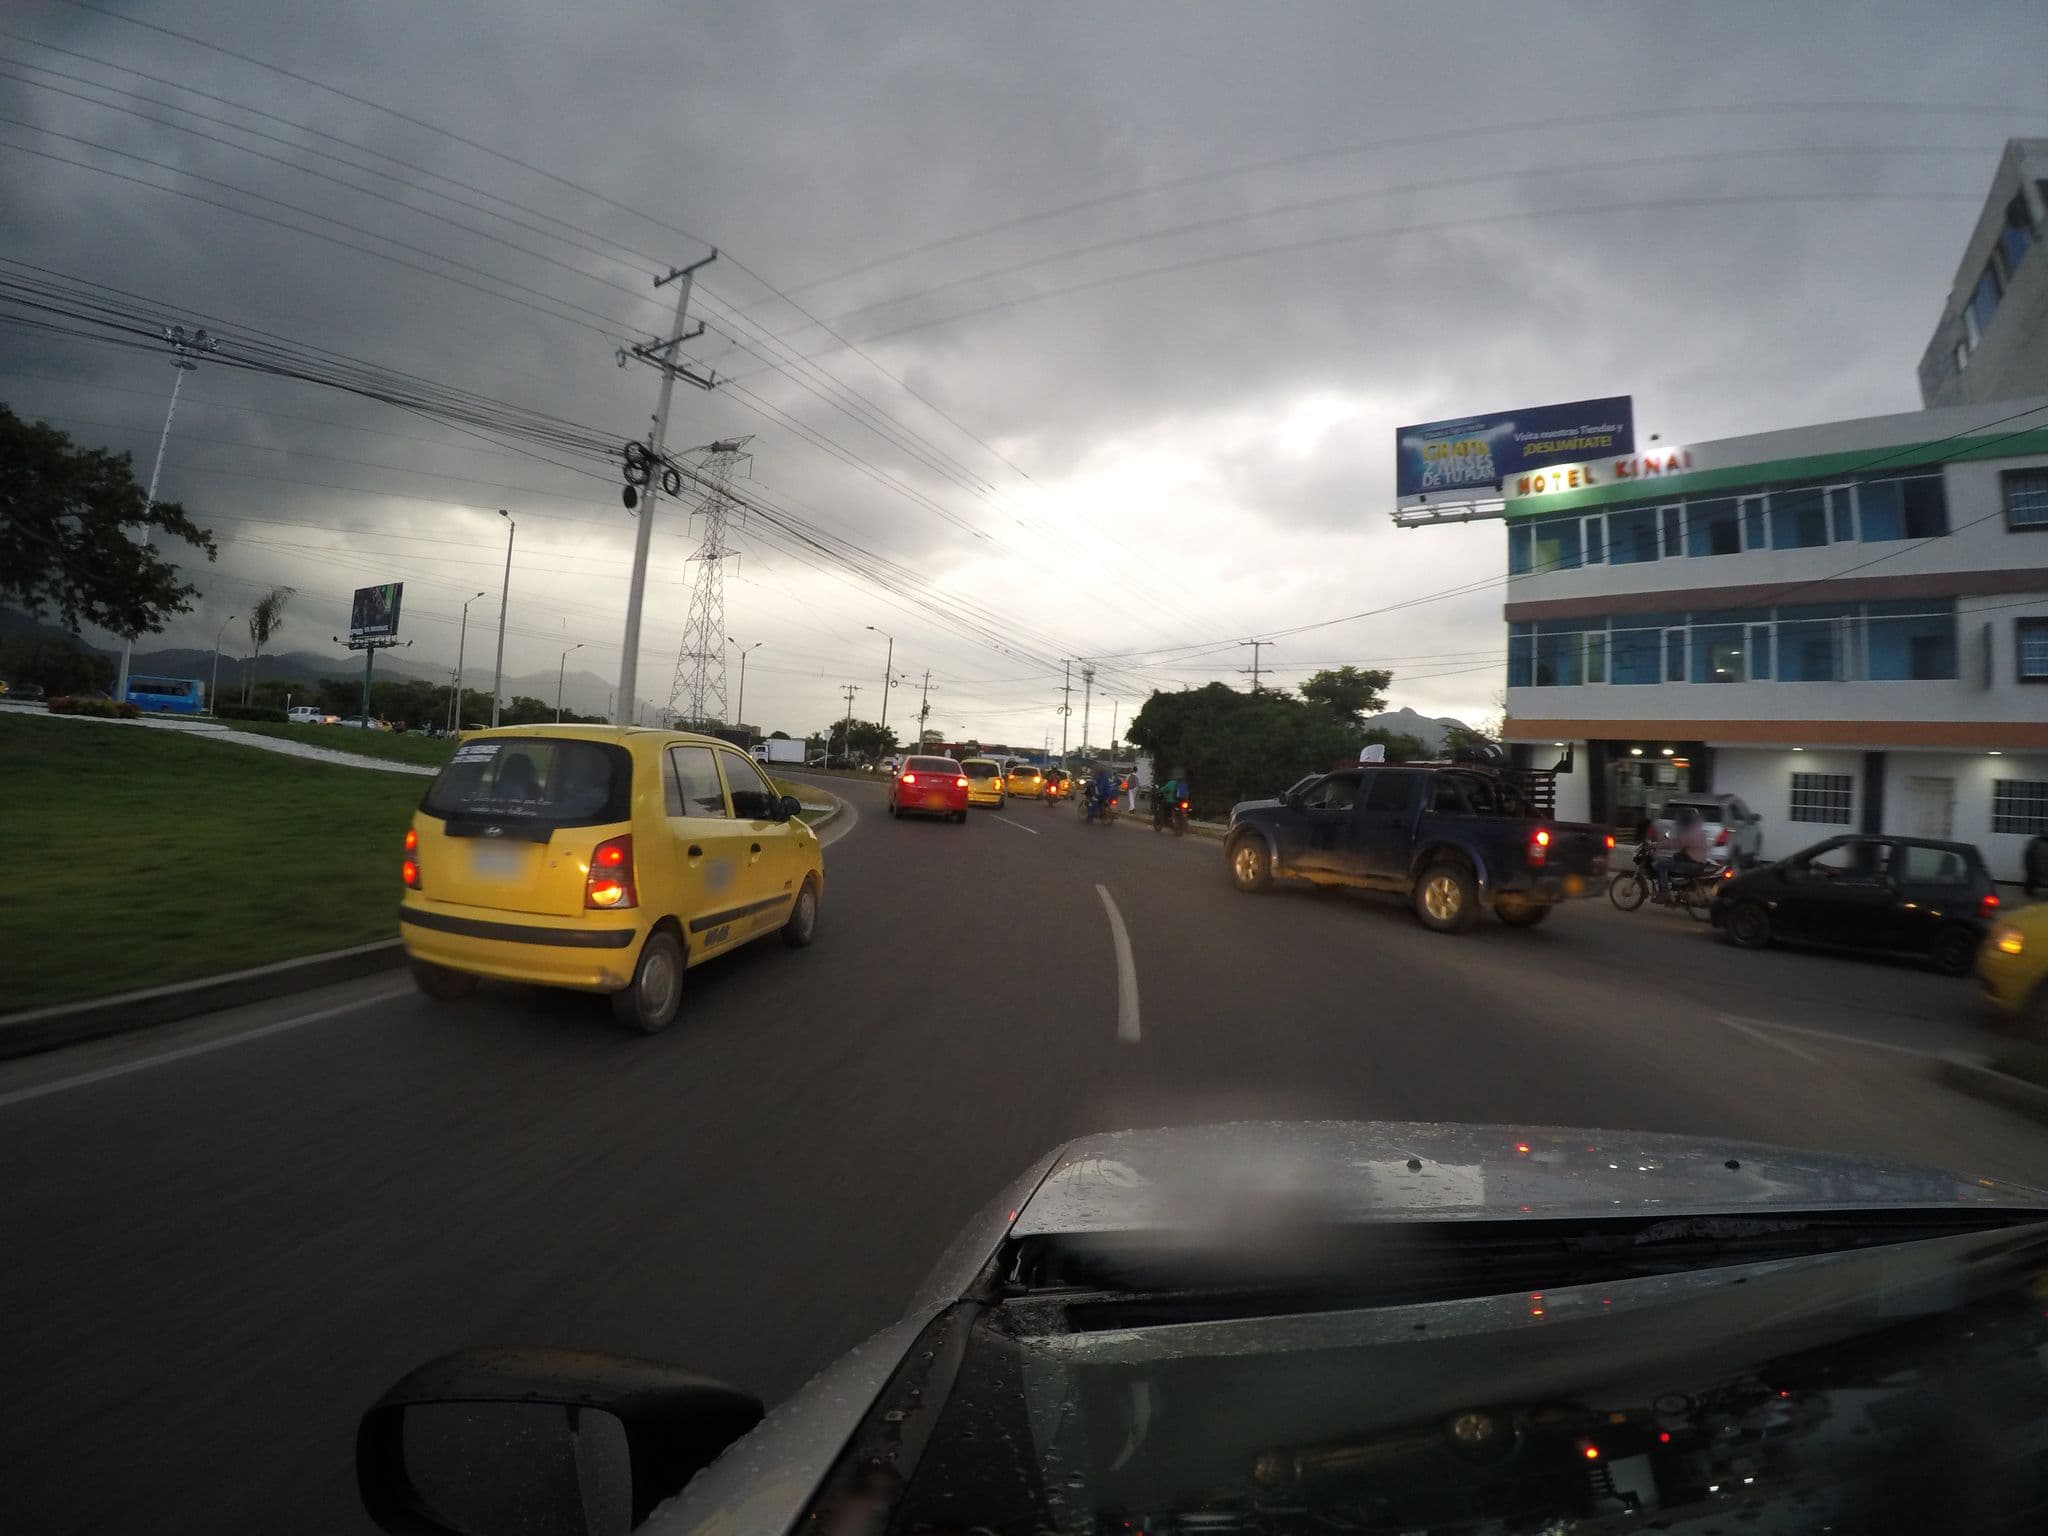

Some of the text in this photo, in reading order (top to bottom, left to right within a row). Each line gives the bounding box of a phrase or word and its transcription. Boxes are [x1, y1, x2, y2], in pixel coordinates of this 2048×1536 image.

[1513, 431, 1539, 442] Visita
[1422, 472, 1441, 487] DE
[1445, 468, 1463, 483] TU
[1516, 449, 1692, 496] HOTEL KINAI
